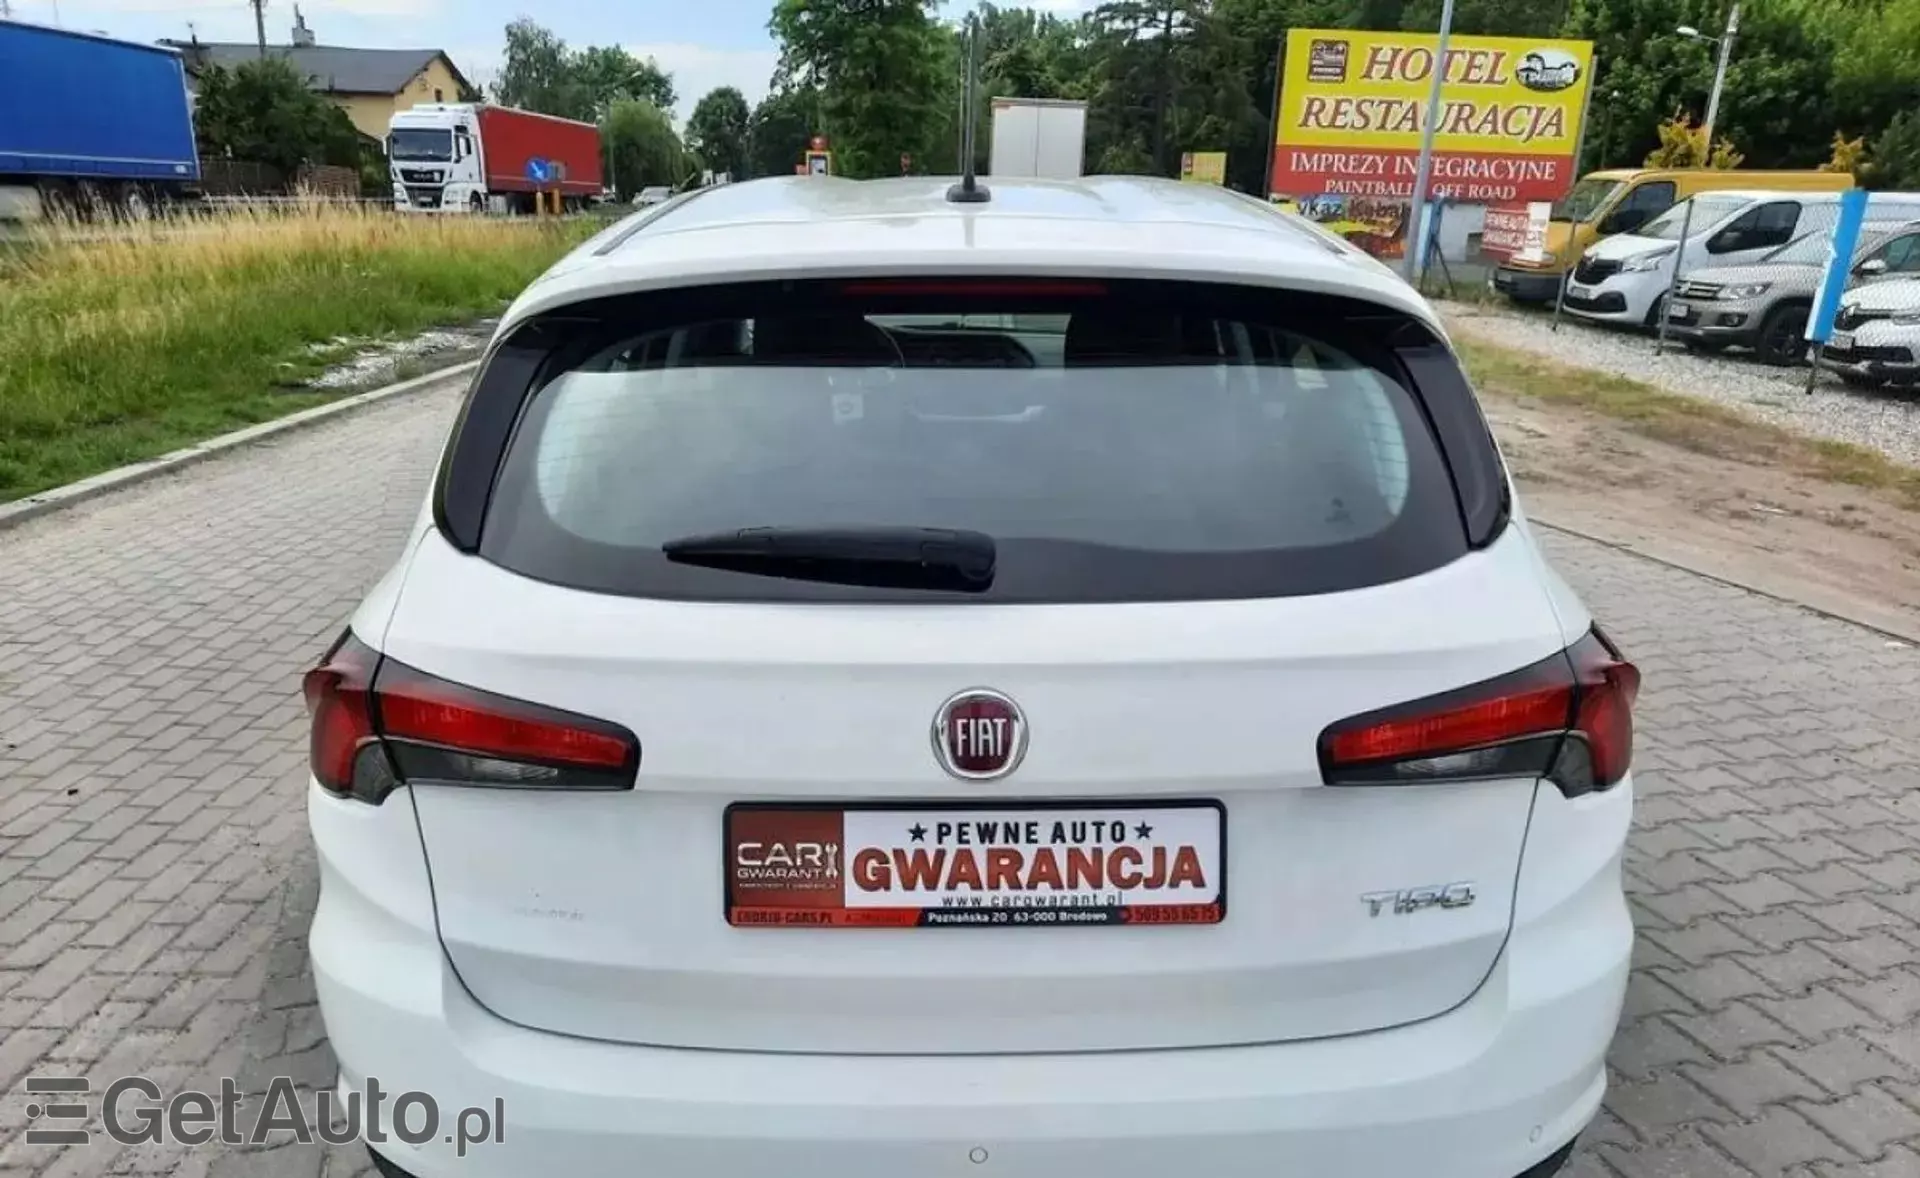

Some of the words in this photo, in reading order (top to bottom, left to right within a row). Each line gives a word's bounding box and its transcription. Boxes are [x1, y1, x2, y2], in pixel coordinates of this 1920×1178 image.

[1361, 46, 1509, 85] HOTEL
[1290, 151, 1390, 175] IMPREZY
[1394, 155, 1557, 183] INEGRACYJNE
[1432, 183, 1464, 198] OFF
[1468, 184, 1517, 199] ROAD
[956, 718, 1008, 757] FIAT
[936, 821, 1039, 844] PEWNE
[1050, 820, 1127, 844] AUTO
[737, 843, 823, 867] CAR
[852, 845, 1206, 892] GWARANCJA
[737, 868, 822, 879] GWARANT
[1360, 881, 1476, 918] TIPO
[991, 911, 1008, 923] 20
[1013, 911, 1055, 923] 63-000
